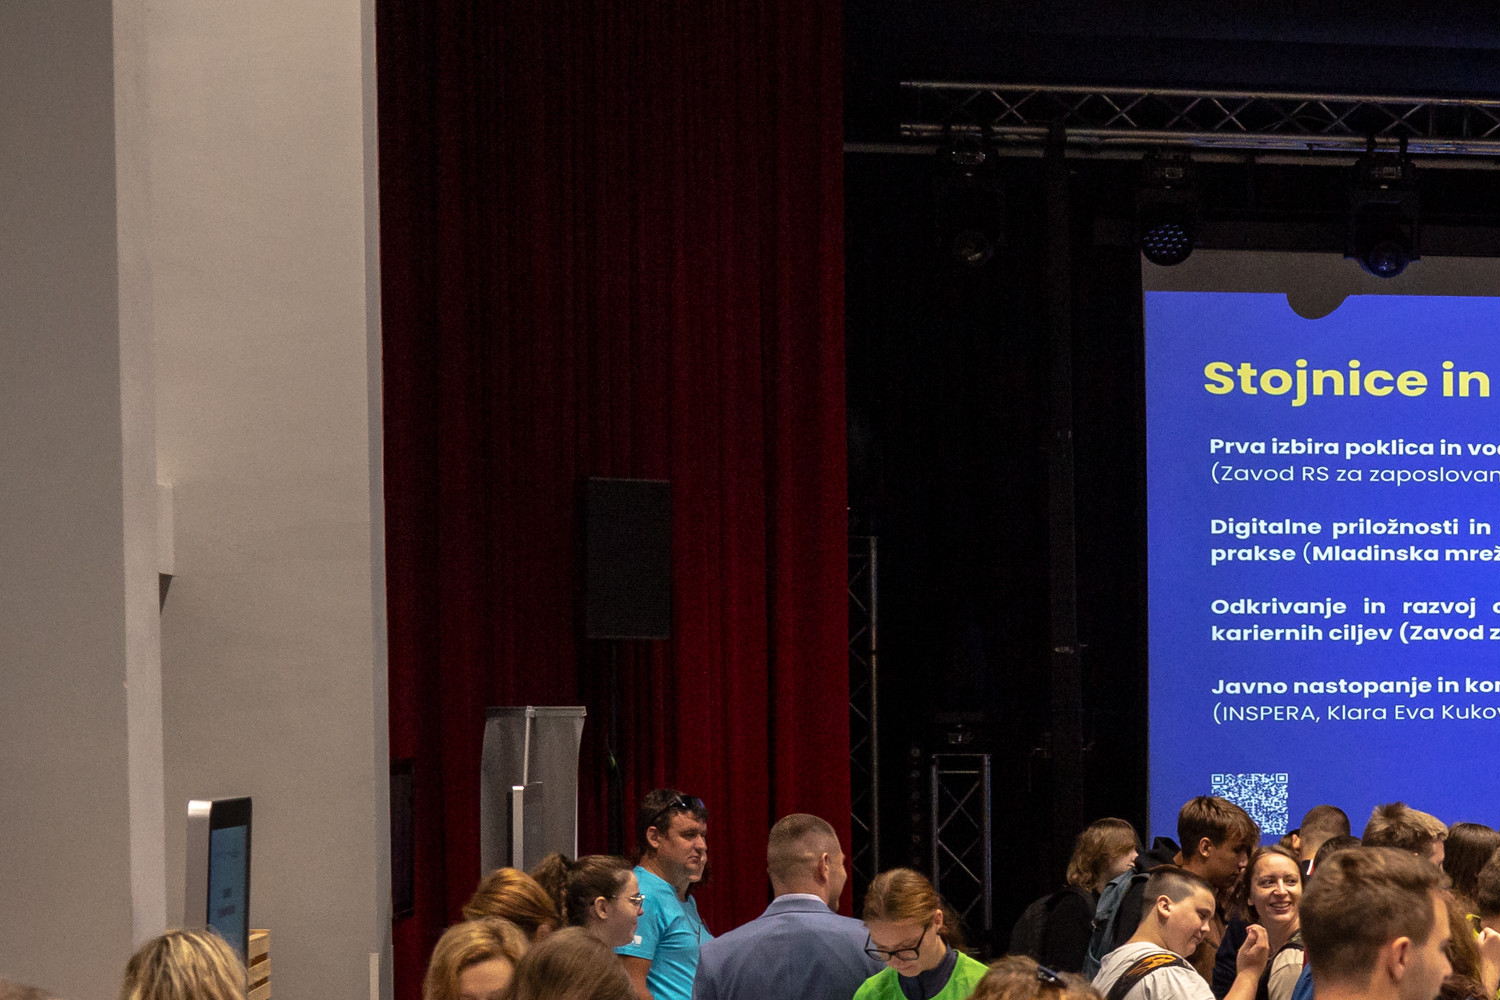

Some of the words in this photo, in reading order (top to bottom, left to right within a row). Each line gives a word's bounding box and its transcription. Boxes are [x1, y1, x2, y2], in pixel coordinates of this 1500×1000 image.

[1203, 358, 1428, 406] Stojnice
[1441, 360, 1489, 397] in
[1210, 438, 1265, 453] Prva
[1271, 437, 1339, 454] izbira
[1345, 438, 1433, 459] poklica
[1440, 438, 1461, 455] in
[1211, 461, 1293, 483] (Zavod
[1302, 466, 1328, 481] RS
[1336, 469, 1361, 481] za
[1210, 517, 1321, 539] Digitalne
[1332, 517, 1458, 539] priložnosti
[1469, 518, 1490, 534] in
[1211, 545, 1296, 565] prakse
[1303, 541, 1438, 564] (Mladinska
[1210, 597, 1346, 618] Odkrivanje
[1363, 597, 1385, 613] in
[1403, 597, 1475, 618] razvoj
[1211, 623, 1322, 640] kariernih
[1328, 623, 1392, 645] ciljev
[1399, 621, 1483, 644] (Zavod
[1211, 679, 1287, 694] Javno
[1293, 676, 1432, 698] nastopanje
[1437, 676, 1459, 692] in
[1213, 701, 1319, 724] (INSPERA,
[1327, 704, 1386, 720] Klara
[1394, 704, 1433, 719] Eva
